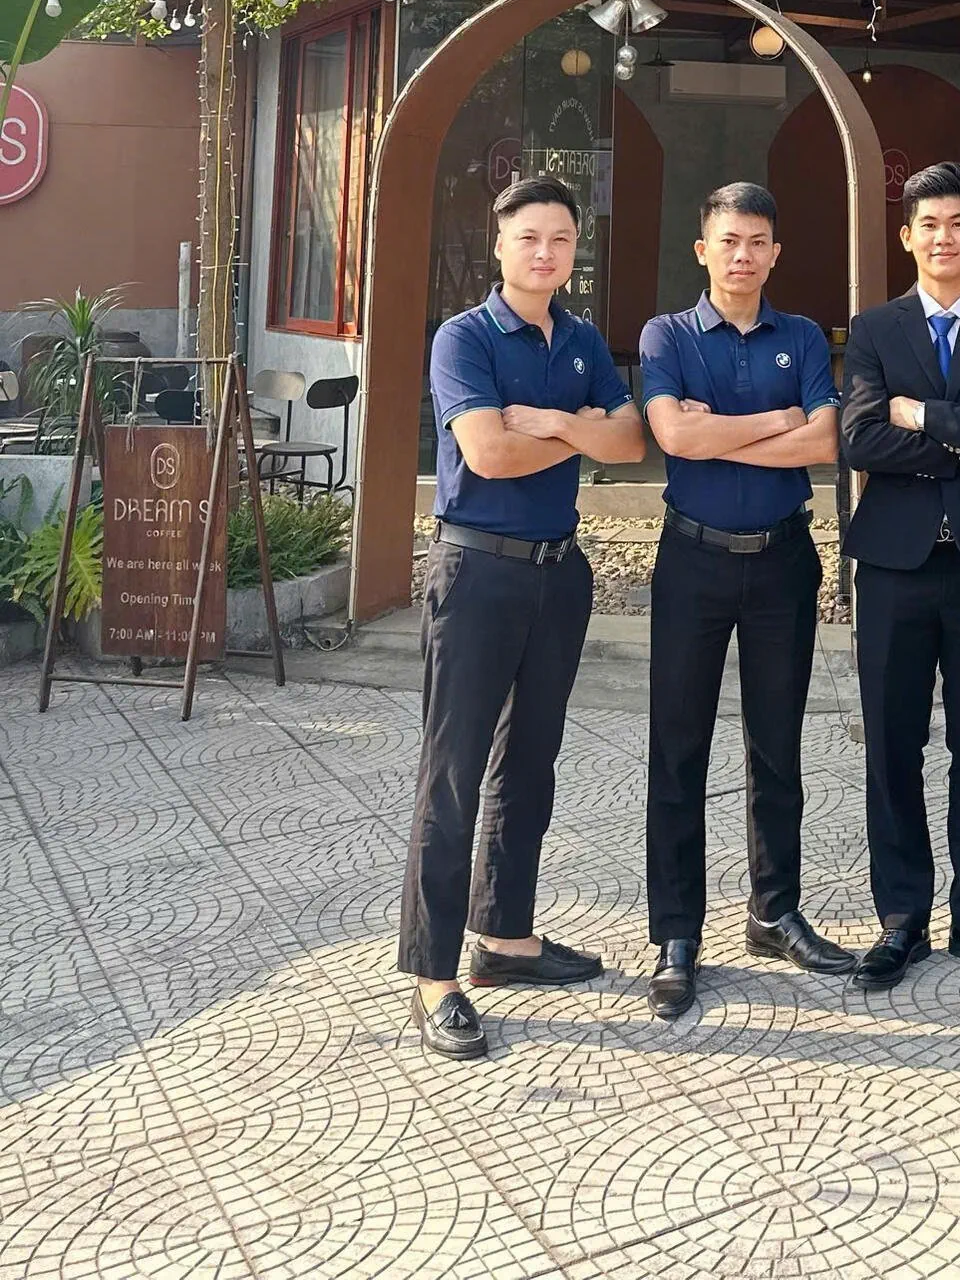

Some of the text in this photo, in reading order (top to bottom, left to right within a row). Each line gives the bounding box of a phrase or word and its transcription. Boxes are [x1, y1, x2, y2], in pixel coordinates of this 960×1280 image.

[156, 457, 175, 475] DS
[114, 498, 192, 524] DREAM
[146, 529, 182, 538] COFFEE
[106, 557, 222, 573] We are here all wek
[120, 592, 169, 608] Opening
[109, 627, 133, 641] 7:00
